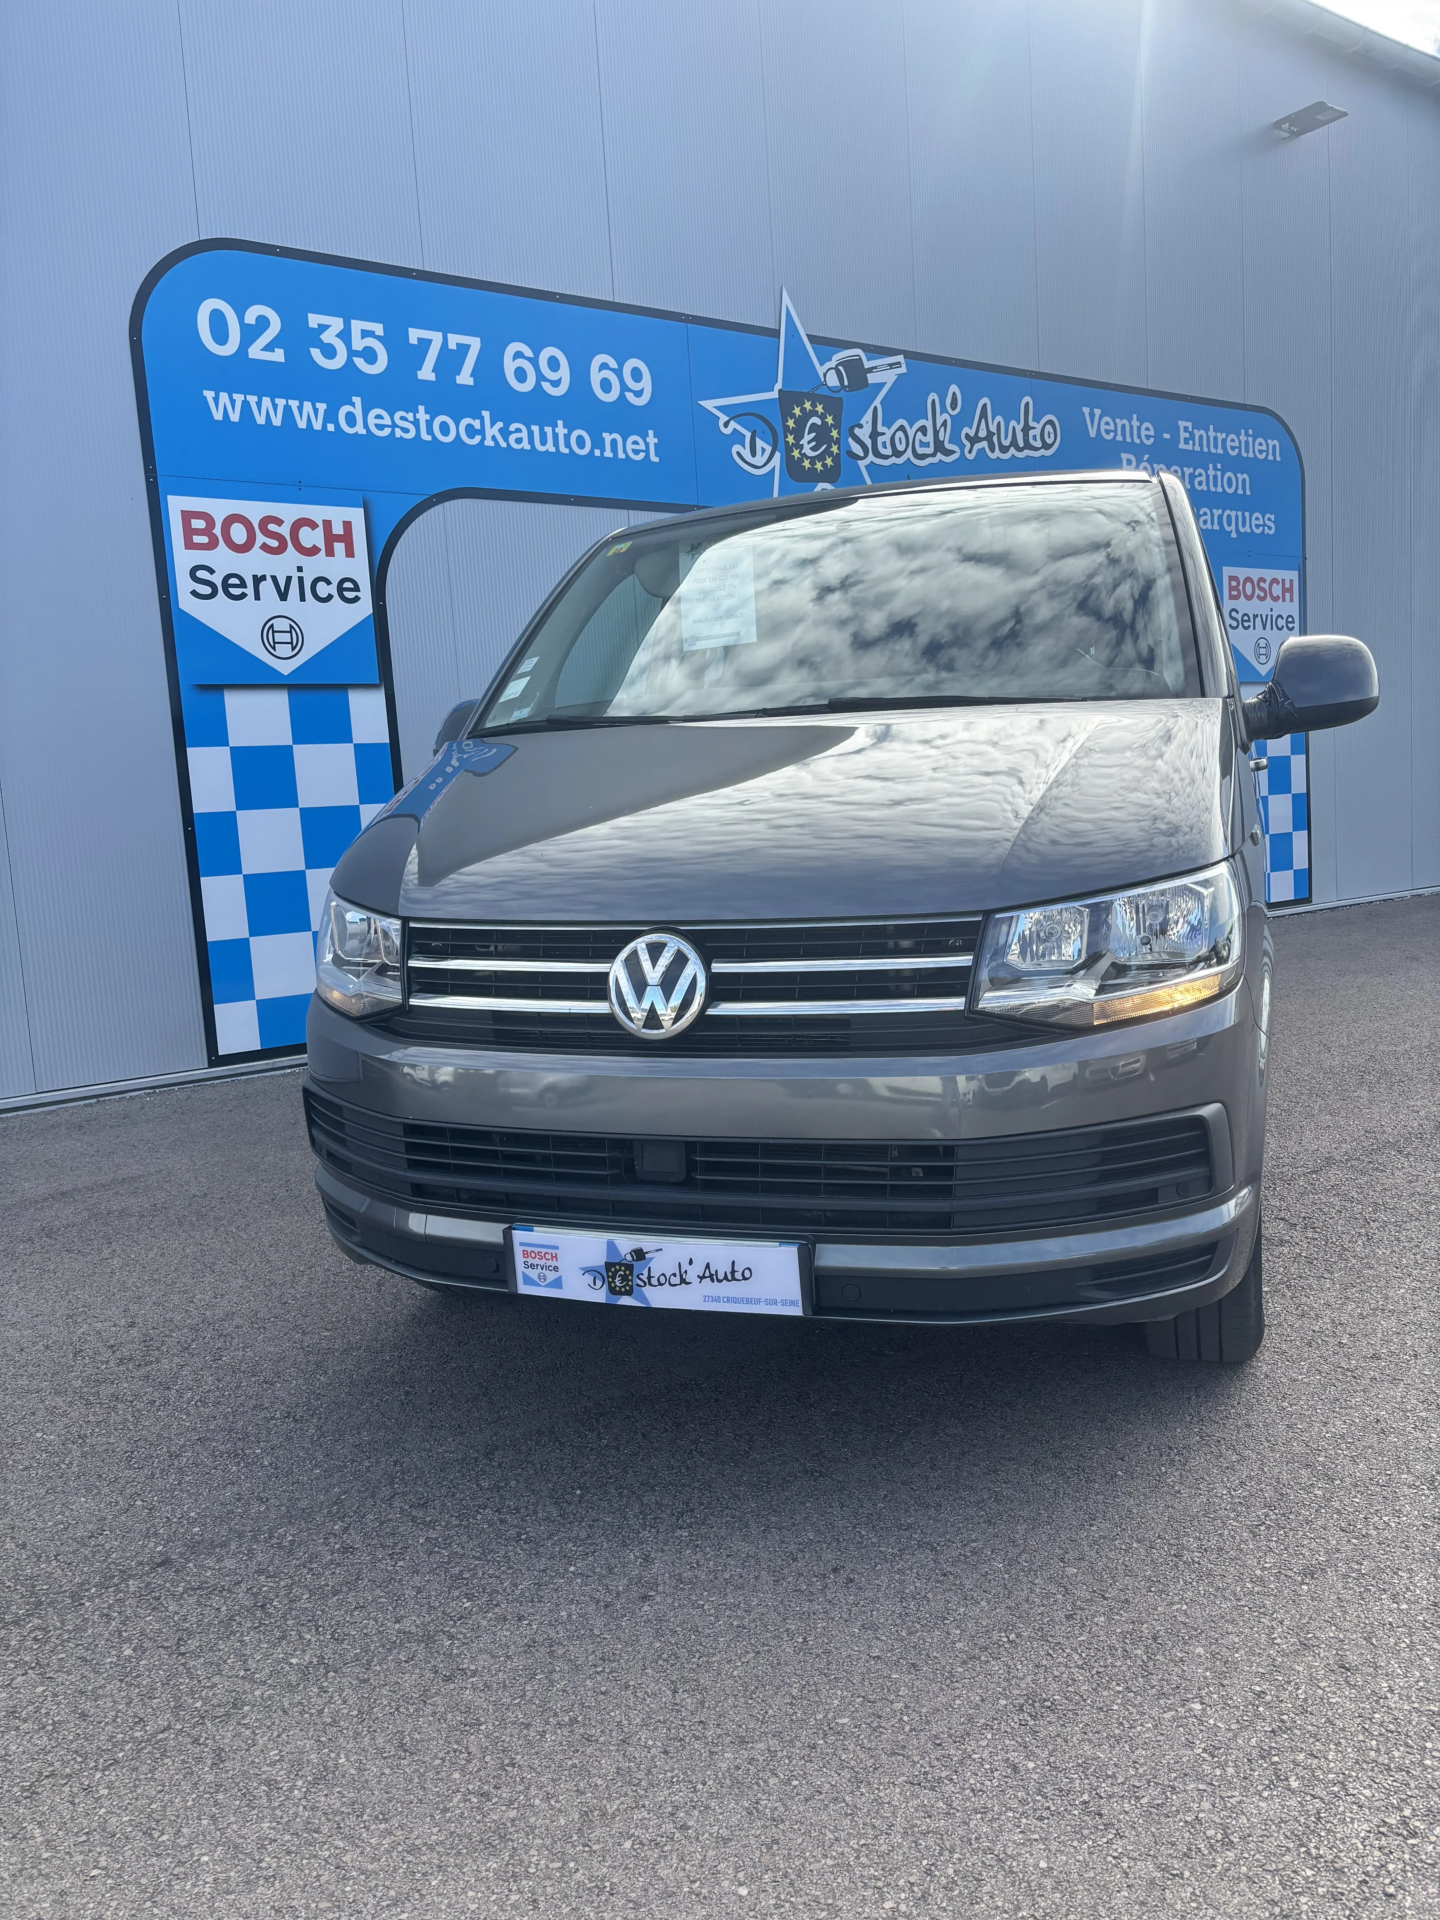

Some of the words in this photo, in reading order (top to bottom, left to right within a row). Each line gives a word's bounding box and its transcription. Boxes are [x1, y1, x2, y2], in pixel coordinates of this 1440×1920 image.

[197, 298, 285, 363] 02
[308, 313, 388, 375] 35
[408, 328, 481, 386] 77
[504, 342, 570, 397] 69
[590, 354, 652, 407] 69
[203, 390, 660, 463] www.destockauto.net
[1082, 407, 1155, 446] Vente
[1178, 420, 1281, 462] Entretien
[181, 510, 355, 559] BOSCH
[1194, 507, 1276, 538] arques
[188, 564, 362, 605] Service
[1228, 575, 1295, 603] BOSCH
[1228, 607, 1296, 632] Service
[522, 1249, 559, 1262] BOSCH
[523, 1260, 560, 1273] Service
[703, 1295, 722, 1304] 27340
[722, 1296, 800, 1308] CRIQUEBEUF-SUR-SEINE
